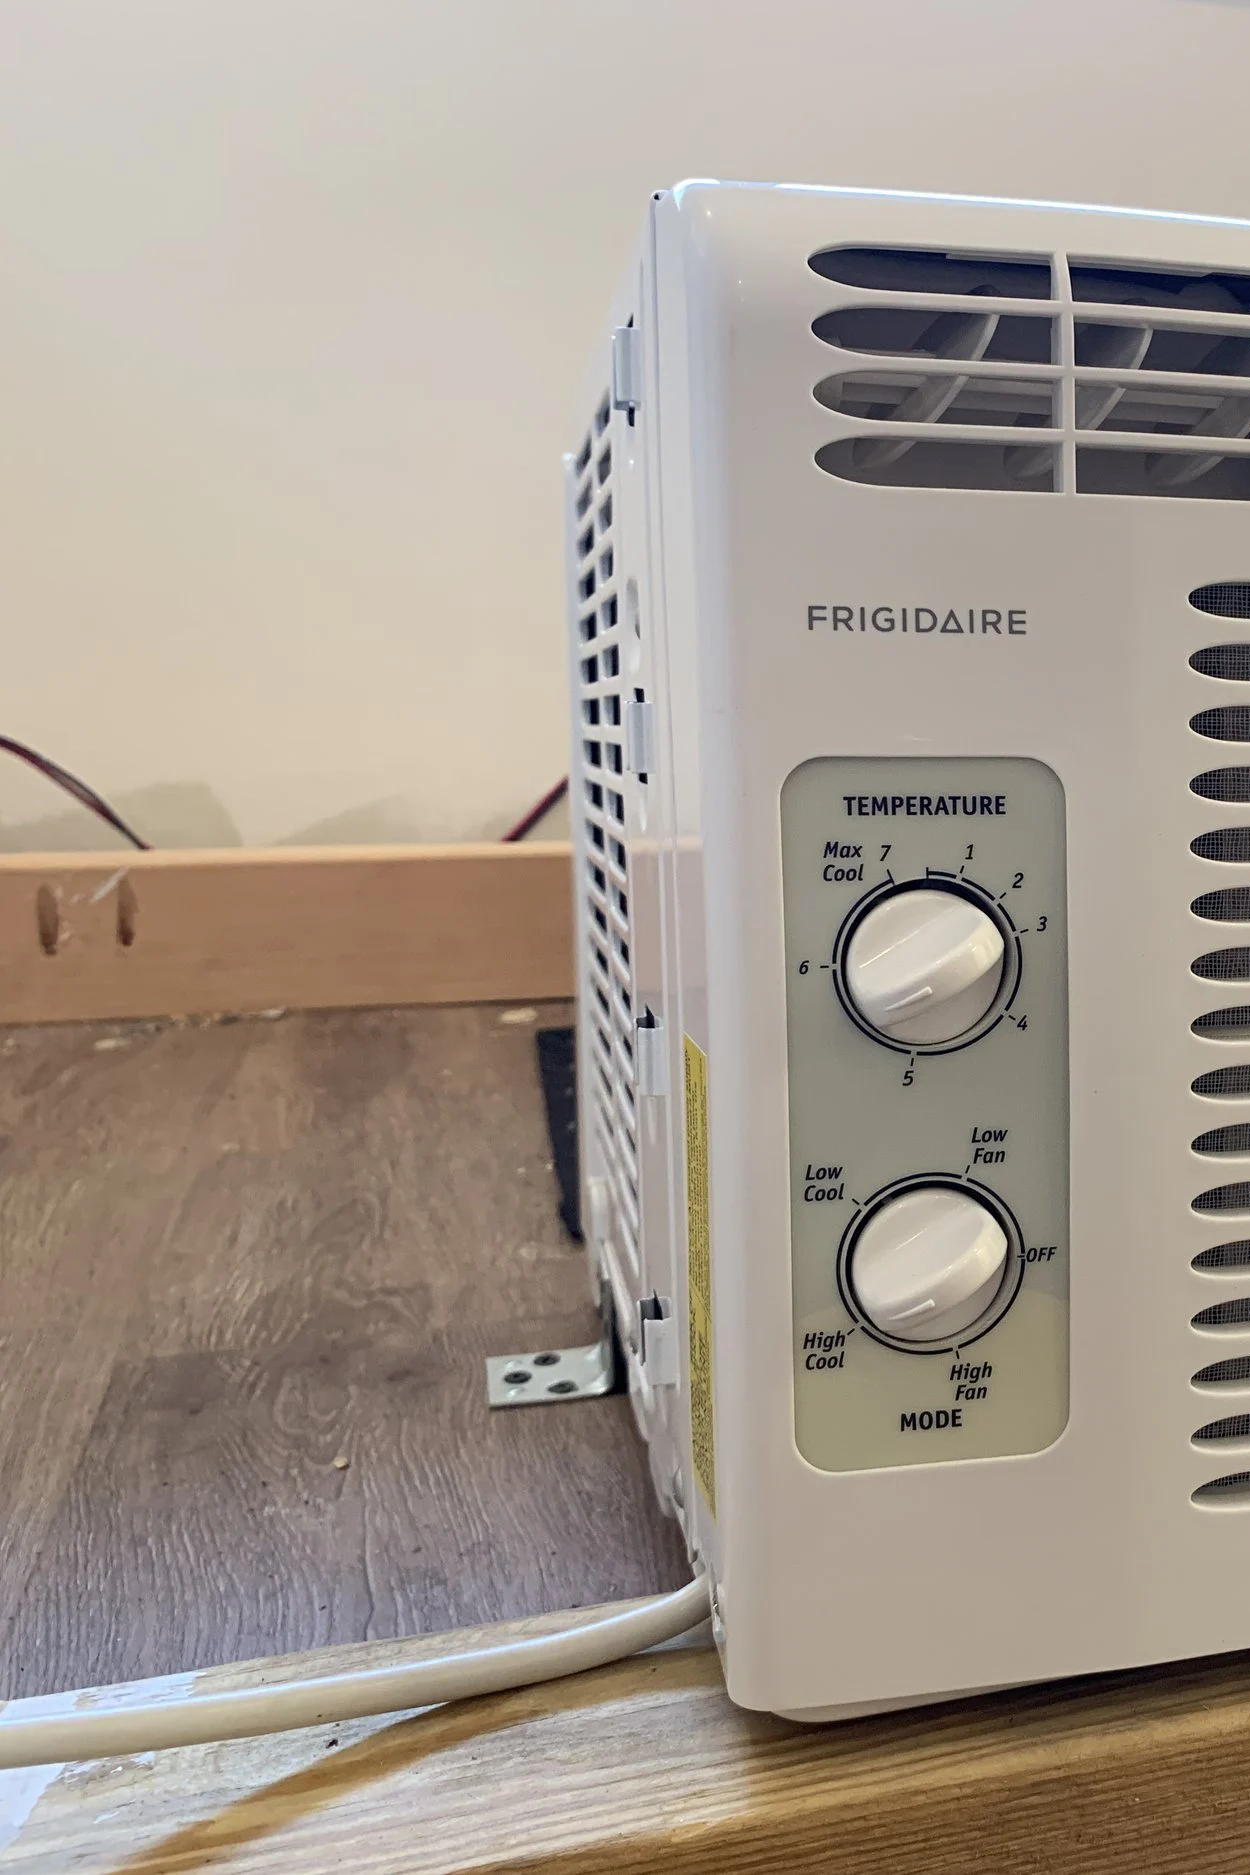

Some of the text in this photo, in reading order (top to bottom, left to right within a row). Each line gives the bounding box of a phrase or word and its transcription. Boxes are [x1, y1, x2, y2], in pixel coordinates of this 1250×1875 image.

[807, 605, 1027, 635] FRIGIDAIRE
[842, 795, 1007, 816] TEMPERATURE
[823, 841, 863, 859] Max
[879, 844, 892, 862] 7
[964, 843, 974, 860] 1
[822, 863, 864, 882] Cool
[1011, 872, 1024, 889] 2
[1036, 915, 1048, 932] 3
[798, 959, 810, 975] 6
[1016, 1014, 1028, 1031] 4
[902, 1070, 915, 1087] 5
[971, 1126, 1009, 1144] Low
[972, 1147, 1006, 1165] Fan
[805, 1164, 844, 1181] Low
[804, 1182, 845, 1203] Cool
[1025, 1246, 1058, 1263] OFF
[802, 1329, 846, 1353] High
[805, 1353, 845, 1371] Cool
[949, 1361, 993, 1384] High
[954, 1384, 988, 1402] Fan
[900, 1408, 963, 1432] MODE
